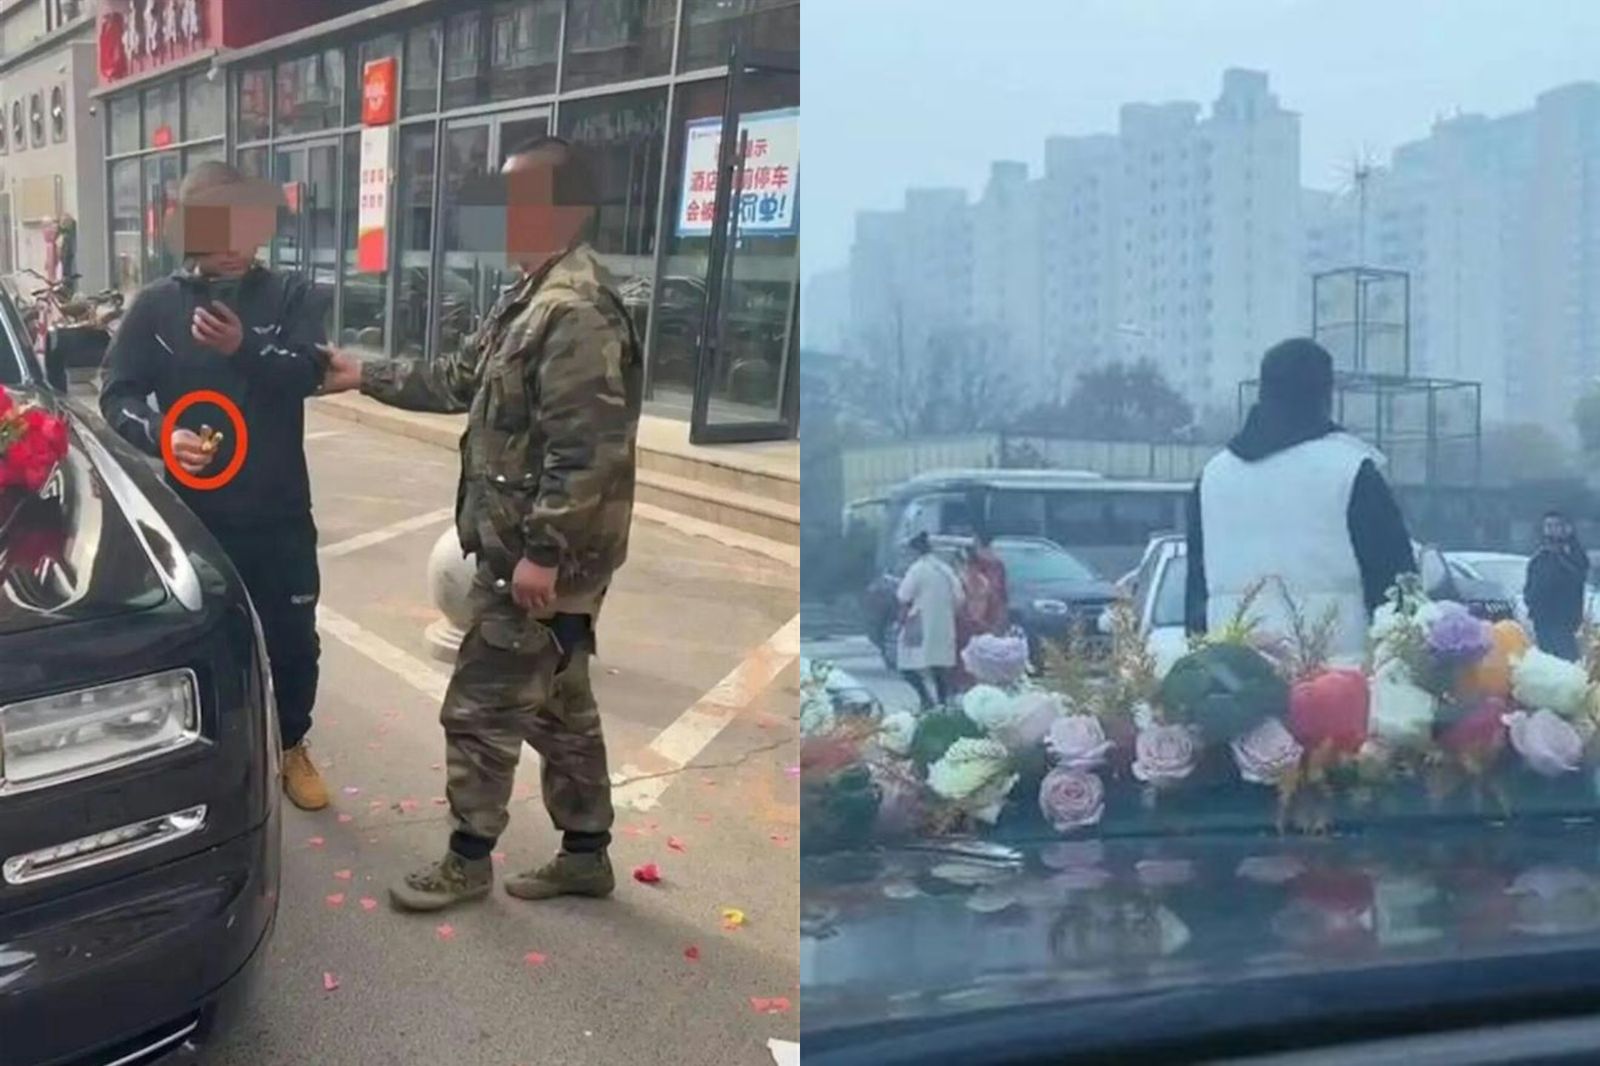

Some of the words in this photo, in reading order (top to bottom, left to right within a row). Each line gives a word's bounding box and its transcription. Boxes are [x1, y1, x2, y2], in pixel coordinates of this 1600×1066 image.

[690, 166, 788, 192] 酒店前停车
[686, 192, 787, 223] 会被罚单!
